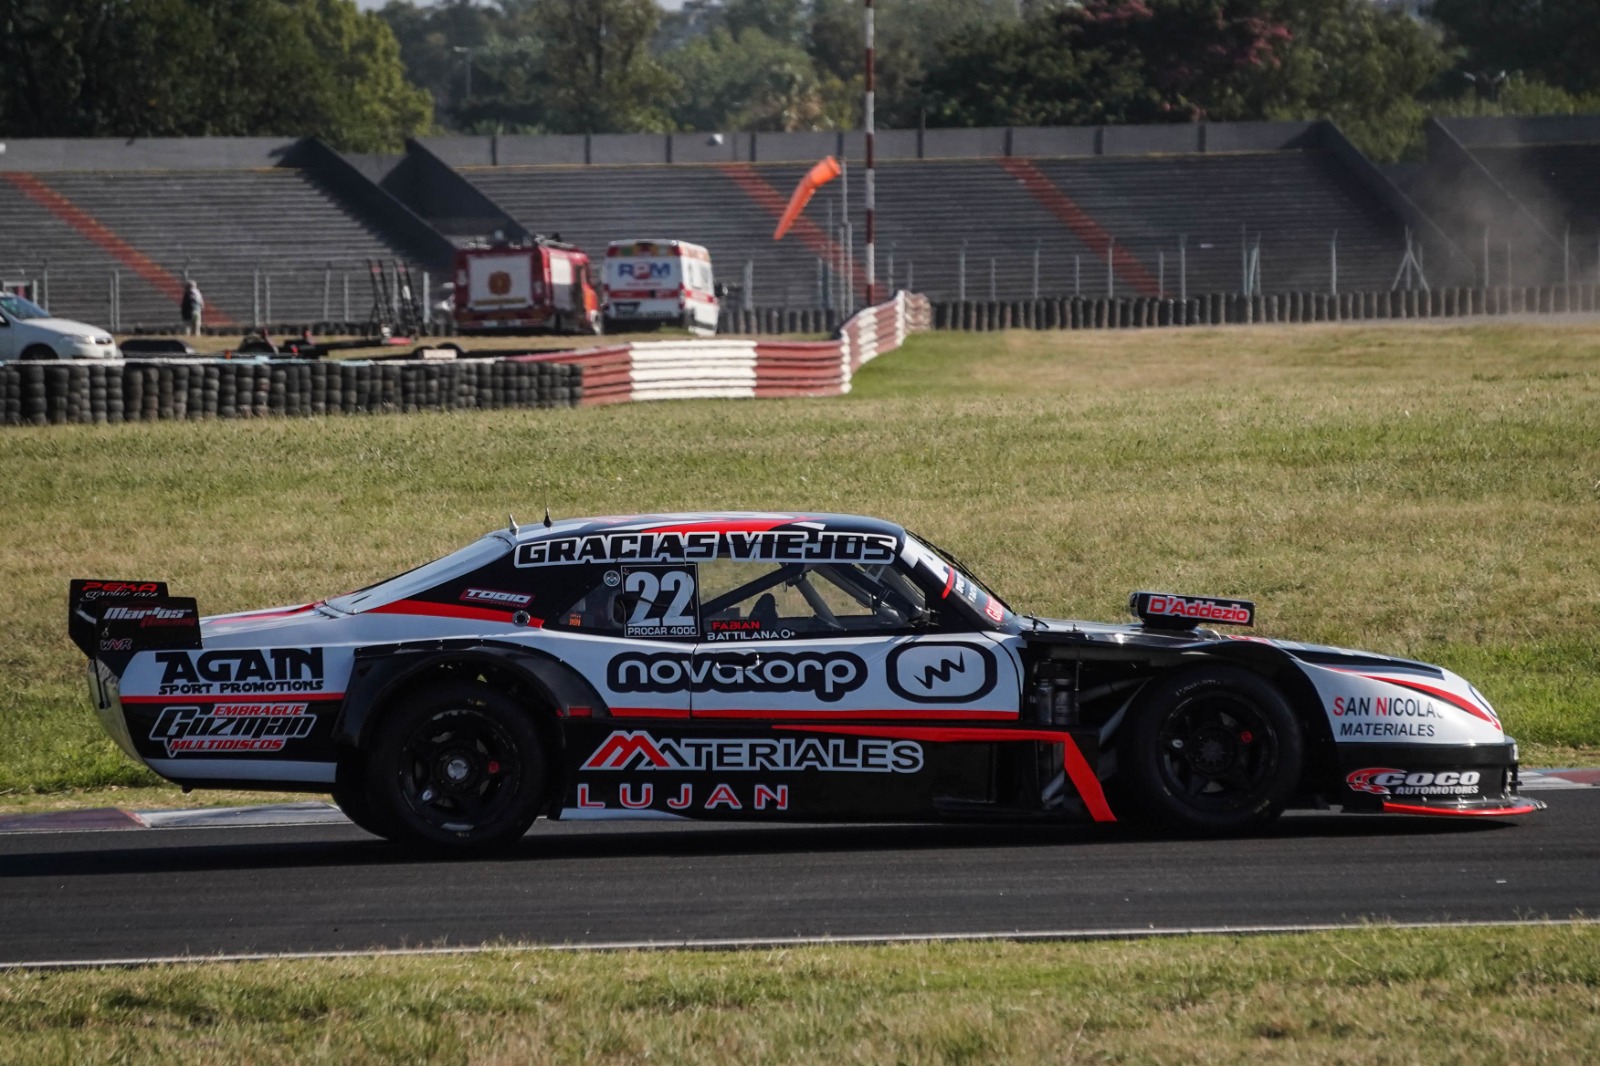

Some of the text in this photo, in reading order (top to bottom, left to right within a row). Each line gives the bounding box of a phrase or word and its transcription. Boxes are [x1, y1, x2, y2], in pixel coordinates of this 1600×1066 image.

[513, 531, 898, 568] GRACIAS VIEJOS
[466, 588, 533, 604] TOBIO
[625, 570, 696, 628] 22
[1147, 594, 1250, 623] D'Addezio
[627, 626, 697, 636] PROCAR 4000
[711, 620, 761, 630] FABIAN
[706, 630, 780, 641] BATTILANA
[155, 647, 324, 683] AGAIN
[618, 657, 858, 693] novakorp
[159, 680, 324, 695] SPORT PROMOTIONS
[213, 704, 307, 717] EMBRAGUE
[1333, 697, 1371, 716] SAN
[150, 707, 317, 742] Guzman
[1340, 723, 1435, 737] MATERIALES
[170, 738, 286, 751] MULTIDISCOS
[579, 731, 924, 774] MATERIALES
[1373, 771, 1481, 786] COCO
[577, 783, 789, 811] LUJAN
[1395, 785, 1479, 795] AUTOMOTORES
